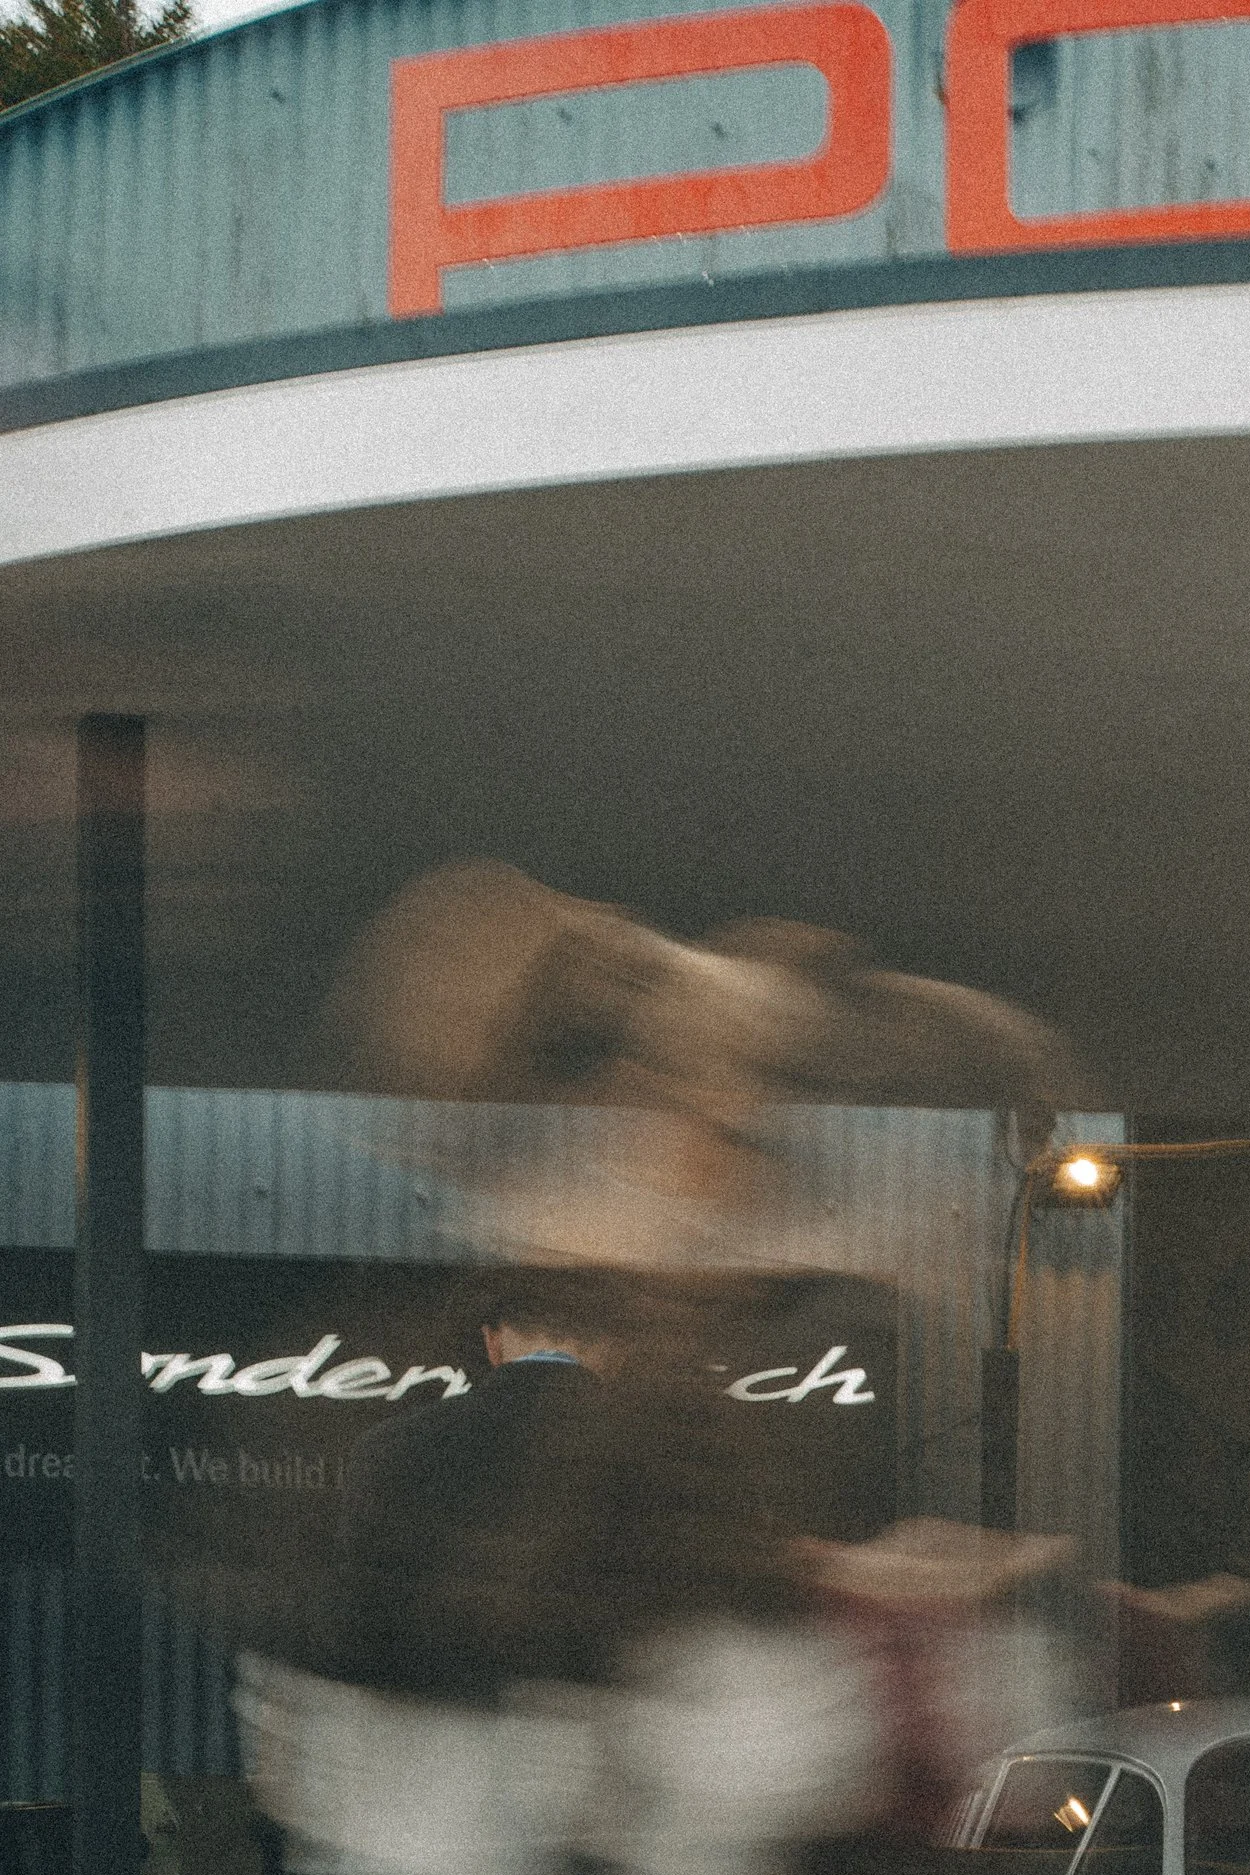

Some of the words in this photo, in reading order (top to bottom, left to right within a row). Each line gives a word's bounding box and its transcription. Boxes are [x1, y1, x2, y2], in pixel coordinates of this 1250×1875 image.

[0, 1323, 876, 1404] Snderch
[169, 1446, 229, 1484] We
[238, 1447, 325, 1489] build
